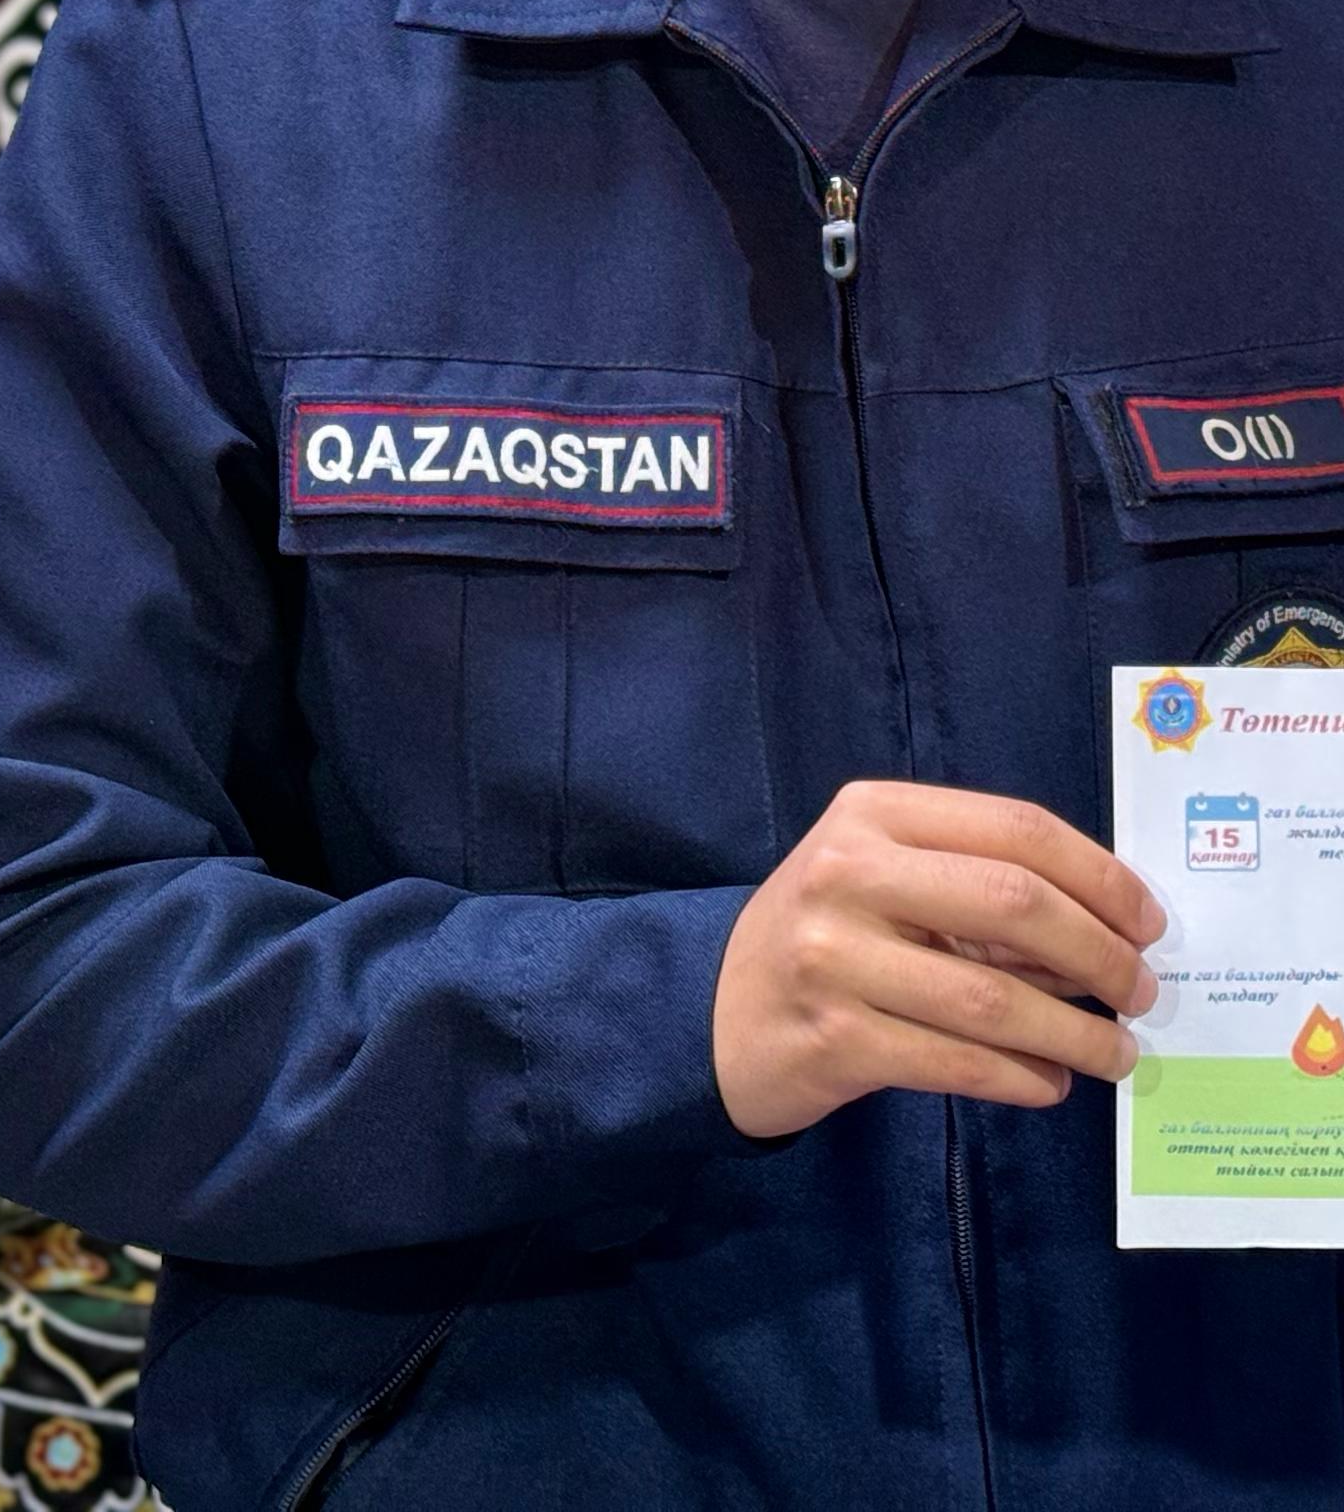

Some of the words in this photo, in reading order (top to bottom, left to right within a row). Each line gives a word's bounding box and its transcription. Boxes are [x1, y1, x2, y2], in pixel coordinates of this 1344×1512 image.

[305, 424, 710, 493] QAZAQSTAN
[1256, 610, 1271, 633] of
[1205, 827, 1241, 849] 15
[1190, 850, 1258, 867] қантар
[1158, 969, 1190, 985] аңа
[1207, 988, 1279, 1005] қолдану
[1166, 1143, 1234, 1157] оттың
[1216, 1163, 1286, 1177] тыйым
